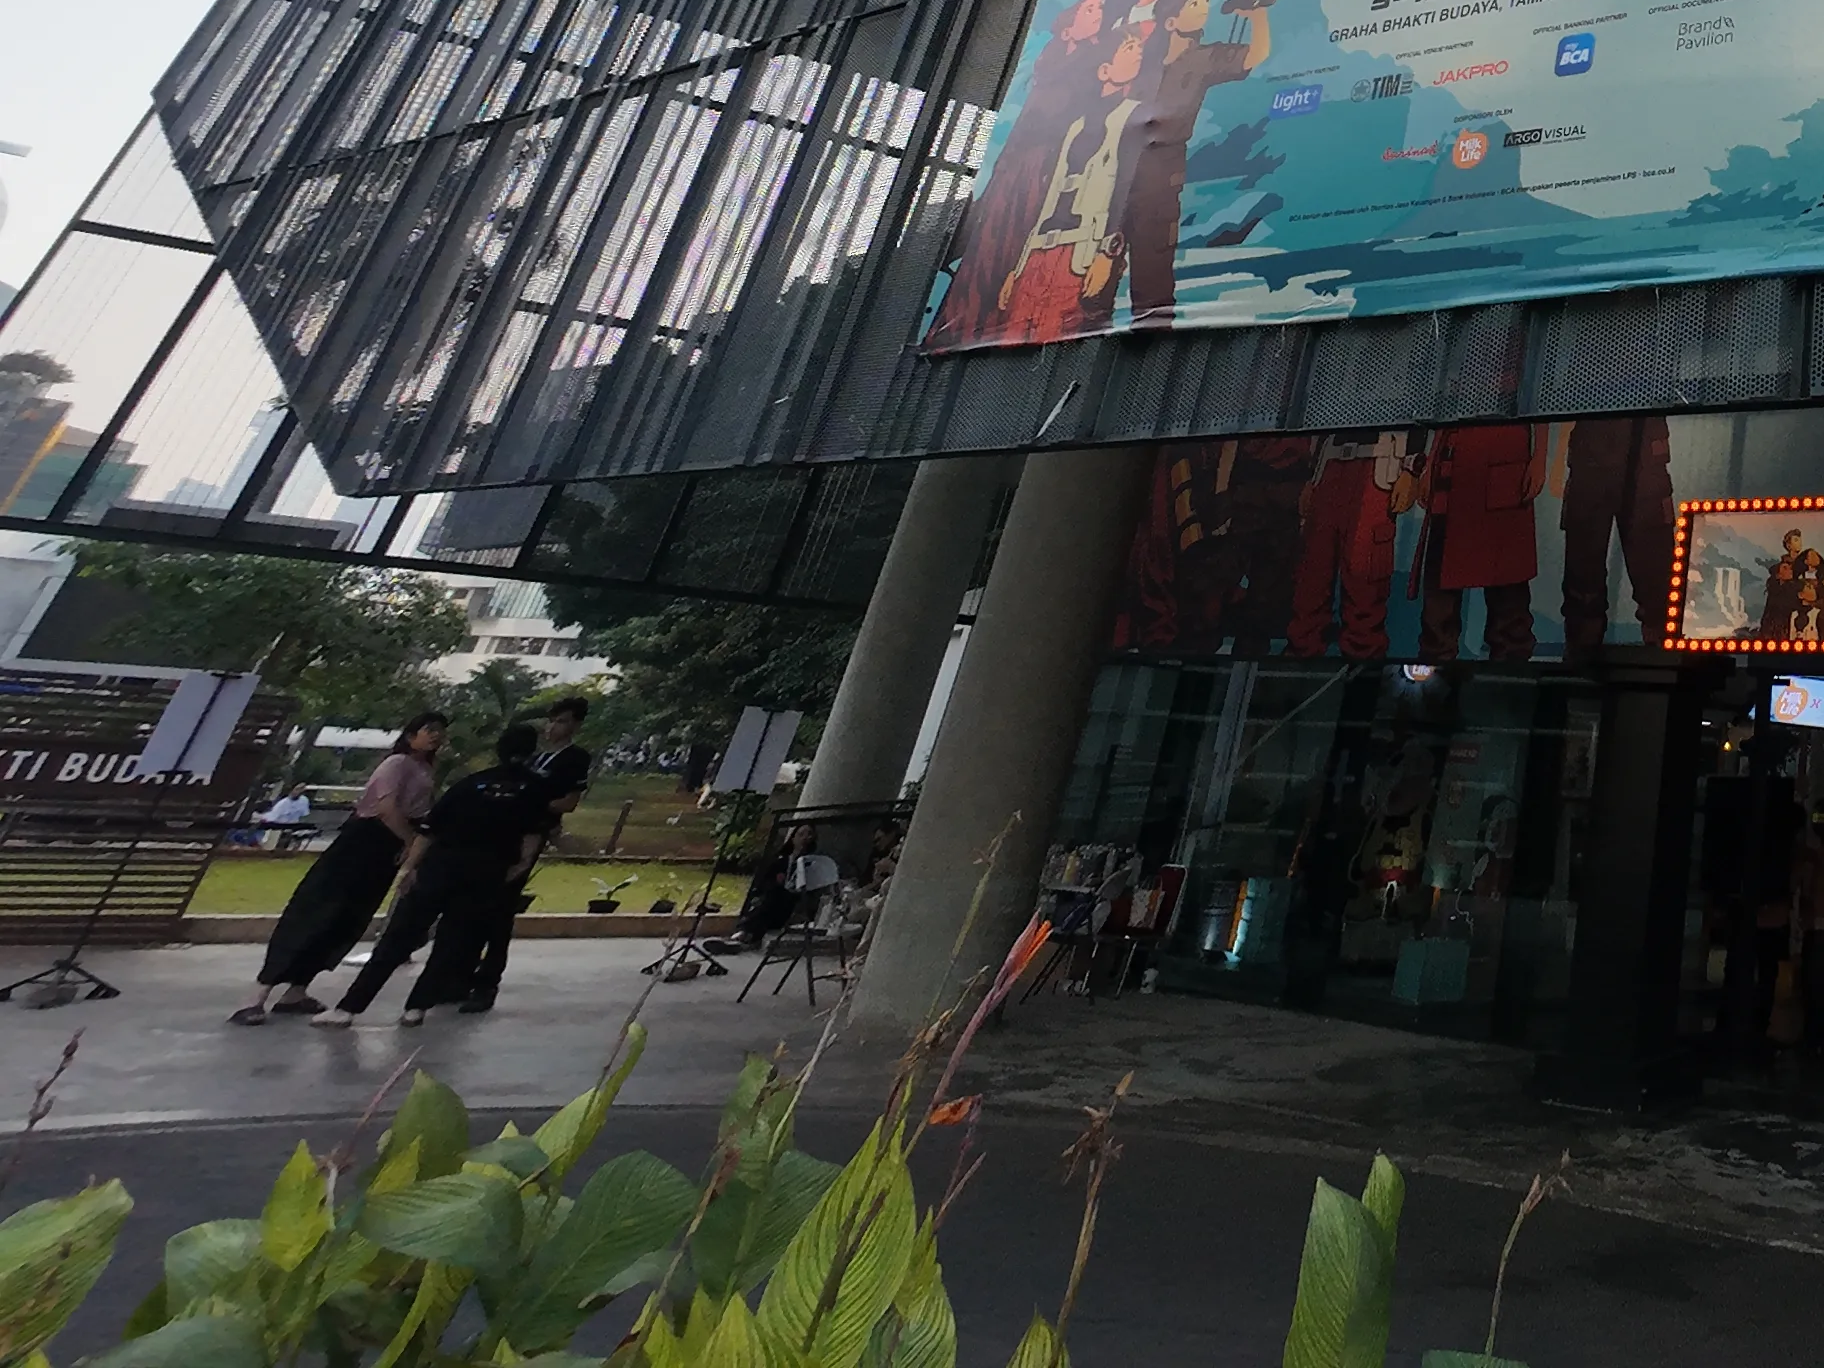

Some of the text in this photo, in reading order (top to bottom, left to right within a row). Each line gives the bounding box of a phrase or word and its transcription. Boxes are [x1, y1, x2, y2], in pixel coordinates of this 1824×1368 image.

[1595, 12, 1627, 24] PARTNER
[1647, 3, 1679, 15] OFFICIAL
[1329, 22, 1377, 43] GRAHA
[1382, 9, 1435, 33] BHAKTI
[1440, 0, 1502, 22] BUDAYA,
[1678, 16, 1721, 35] Brand
[1676, 32, 1734, 50] Pavilion
[1560, 48, 1590, 66] BCA
[1433, 60, 1509, 86] JAKPRO
[1505, 131, 1540, 145] ARGO
[1544, 125, 1586, 139] VISUAL
[1460, 138, 1481, 151] Milk
[1460, 150, 1481, 162] Life
